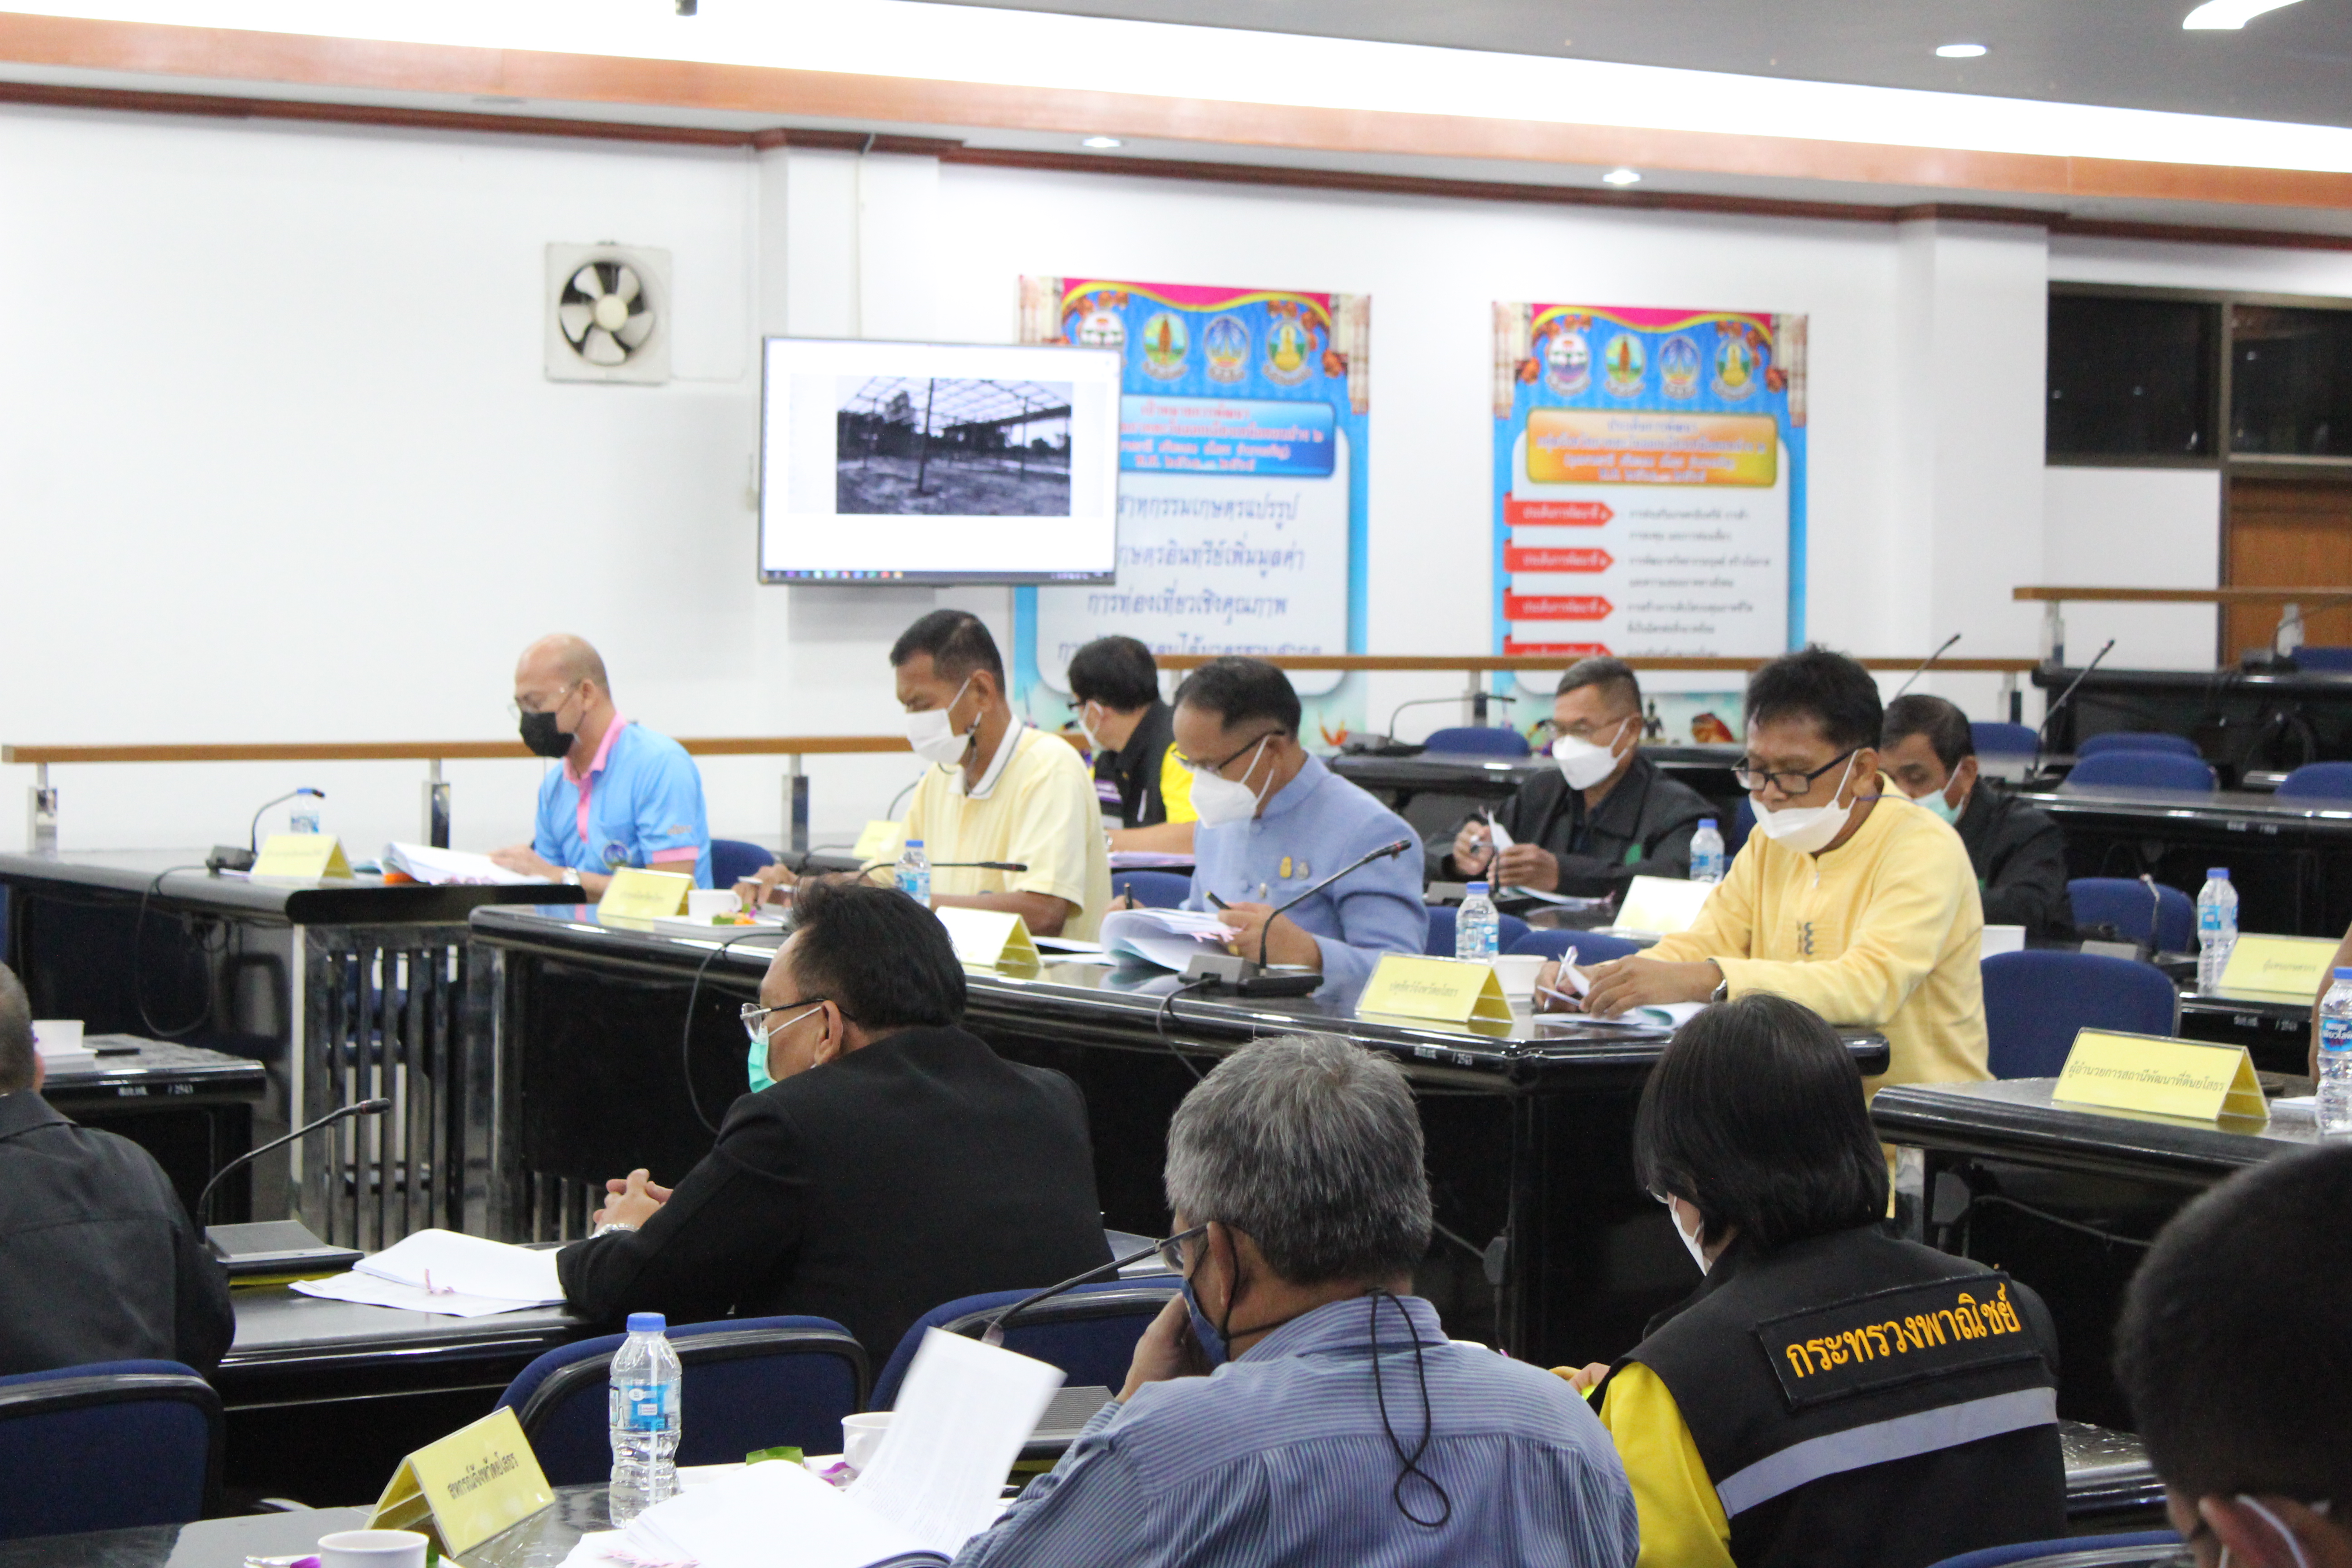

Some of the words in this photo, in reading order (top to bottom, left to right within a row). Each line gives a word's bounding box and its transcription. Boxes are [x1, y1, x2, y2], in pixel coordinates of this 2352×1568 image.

[1119, 532, 1303, 578] กษตรอินทรีย์เพิ่มมูลค่า
[2068, 1060, 2225, 1092] ผู้อำนวยการสถานีพัฒนาที่ดินยโสธร
[1786, 1283, 2021, 1378] กระทรวงพาณิชย์
